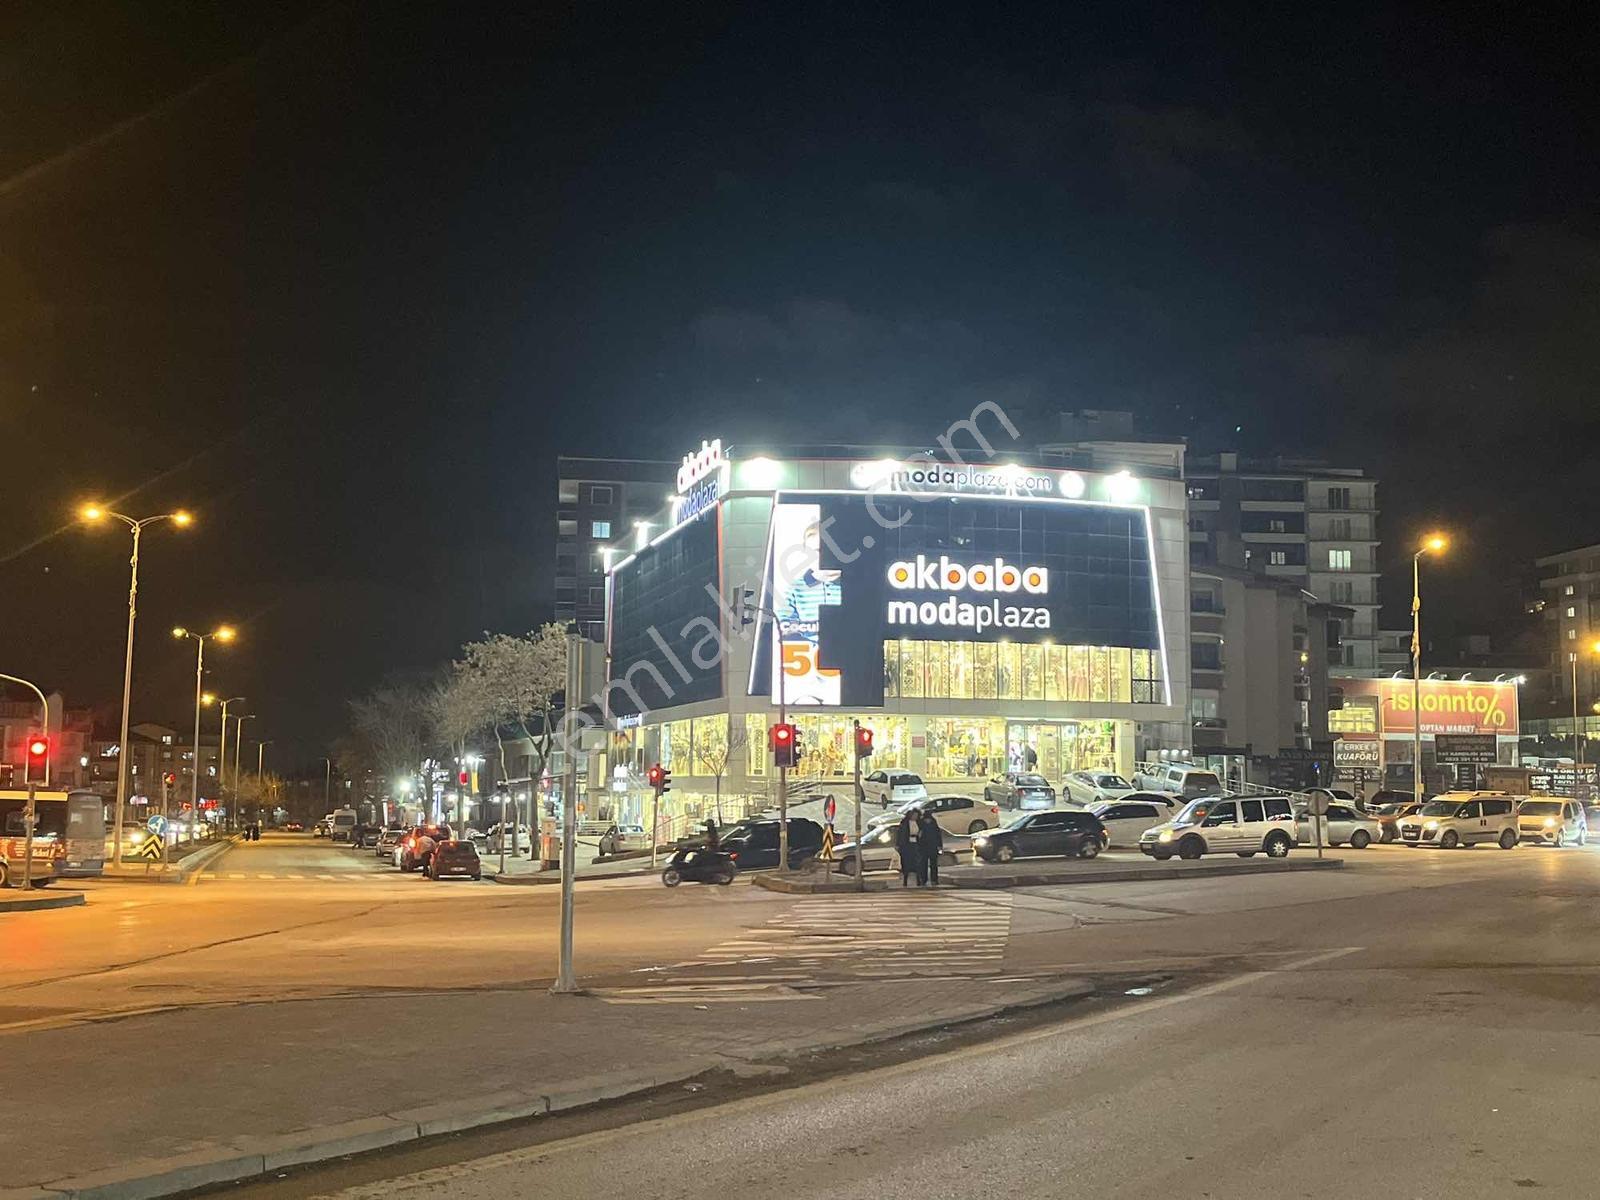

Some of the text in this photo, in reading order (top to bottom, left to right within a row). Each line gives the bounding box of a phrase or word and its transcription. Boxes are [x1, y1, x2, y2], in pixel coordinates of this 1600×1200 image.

[677, 438, 721, 495] akbaba
[891, 463, 1052, 491] modaplazacom
[887, 554, 1049, 594] akbaba
[887, 595, 1051, 634] modaplaza
[1416, 723, 1445, 733] OPTAN
